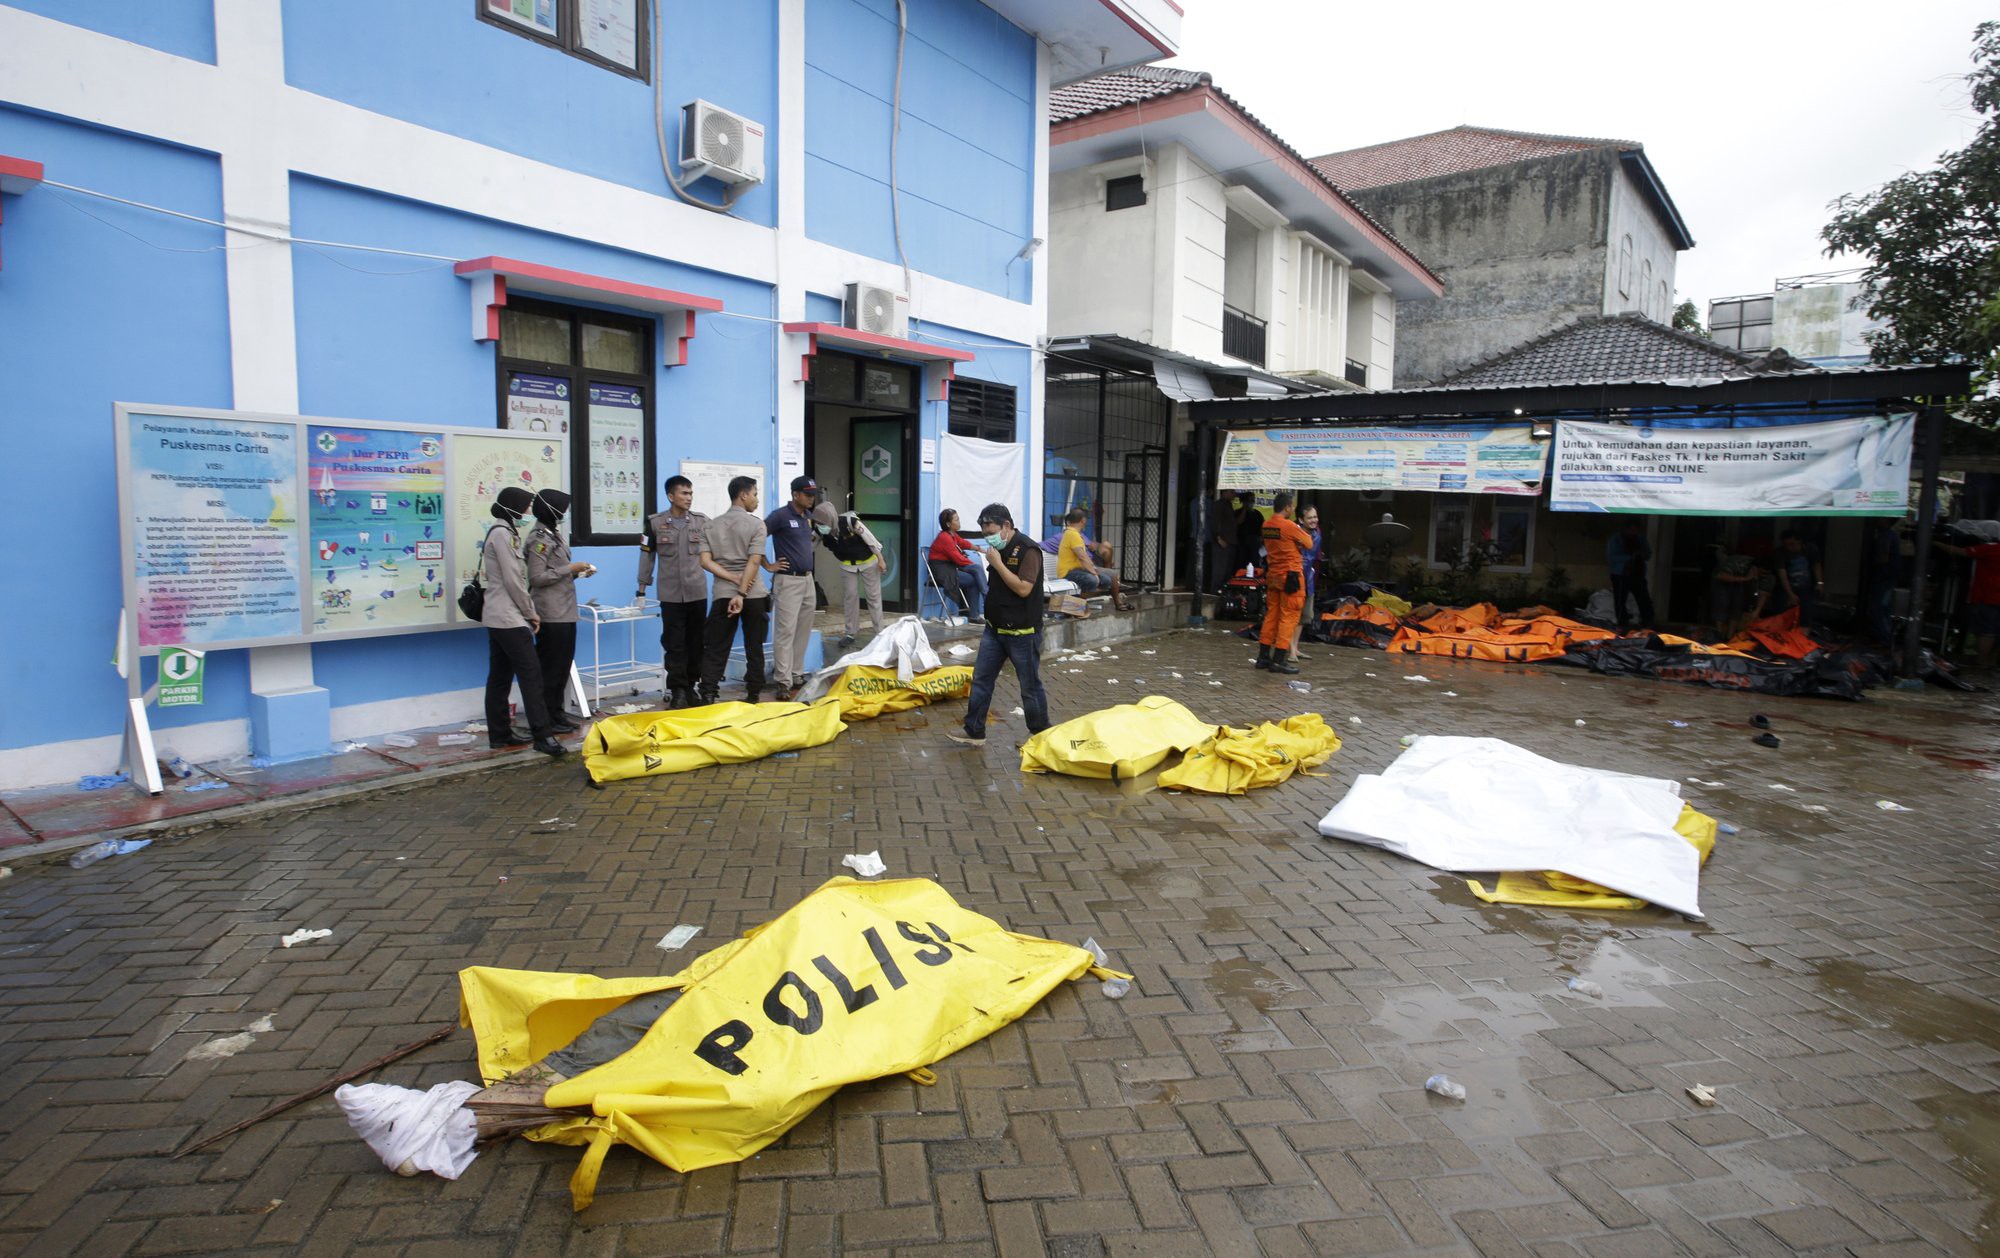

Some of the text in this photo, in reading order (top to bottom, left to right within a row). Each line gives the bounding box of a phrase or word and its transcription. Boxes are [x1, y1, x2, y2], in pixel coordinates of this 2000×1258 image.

[143, 424, 289, 440] Pelayanan Kesehatan Peduli Remaja
[160, 438, 269, 454] Puskesmas Carita
[1562, 440, 1812, 451] Untuk kemudahan dan kepastian layanan,
[352, 449, 409, 460] Alur PKPR
[1562, 452, 1601, 461] rujukan
[1606, 452, 1627, 460] dari
[1631, 453, 1670, 461] Faskes
[1676, 453, 1692, 461] Tk.
[1723, 452, 1767, 461] Rumah
[1772, 452, 1806, 461] Sakit
[333, 463, 431, 474] Puskesmas Carita
[1561, 463, 1613, 472] dilakukan
[1658, 465, 1708, 474] ONLINE.
[161, 686, 198, 695] PARKIR
[162, 695, 197, 703] MOTOR
